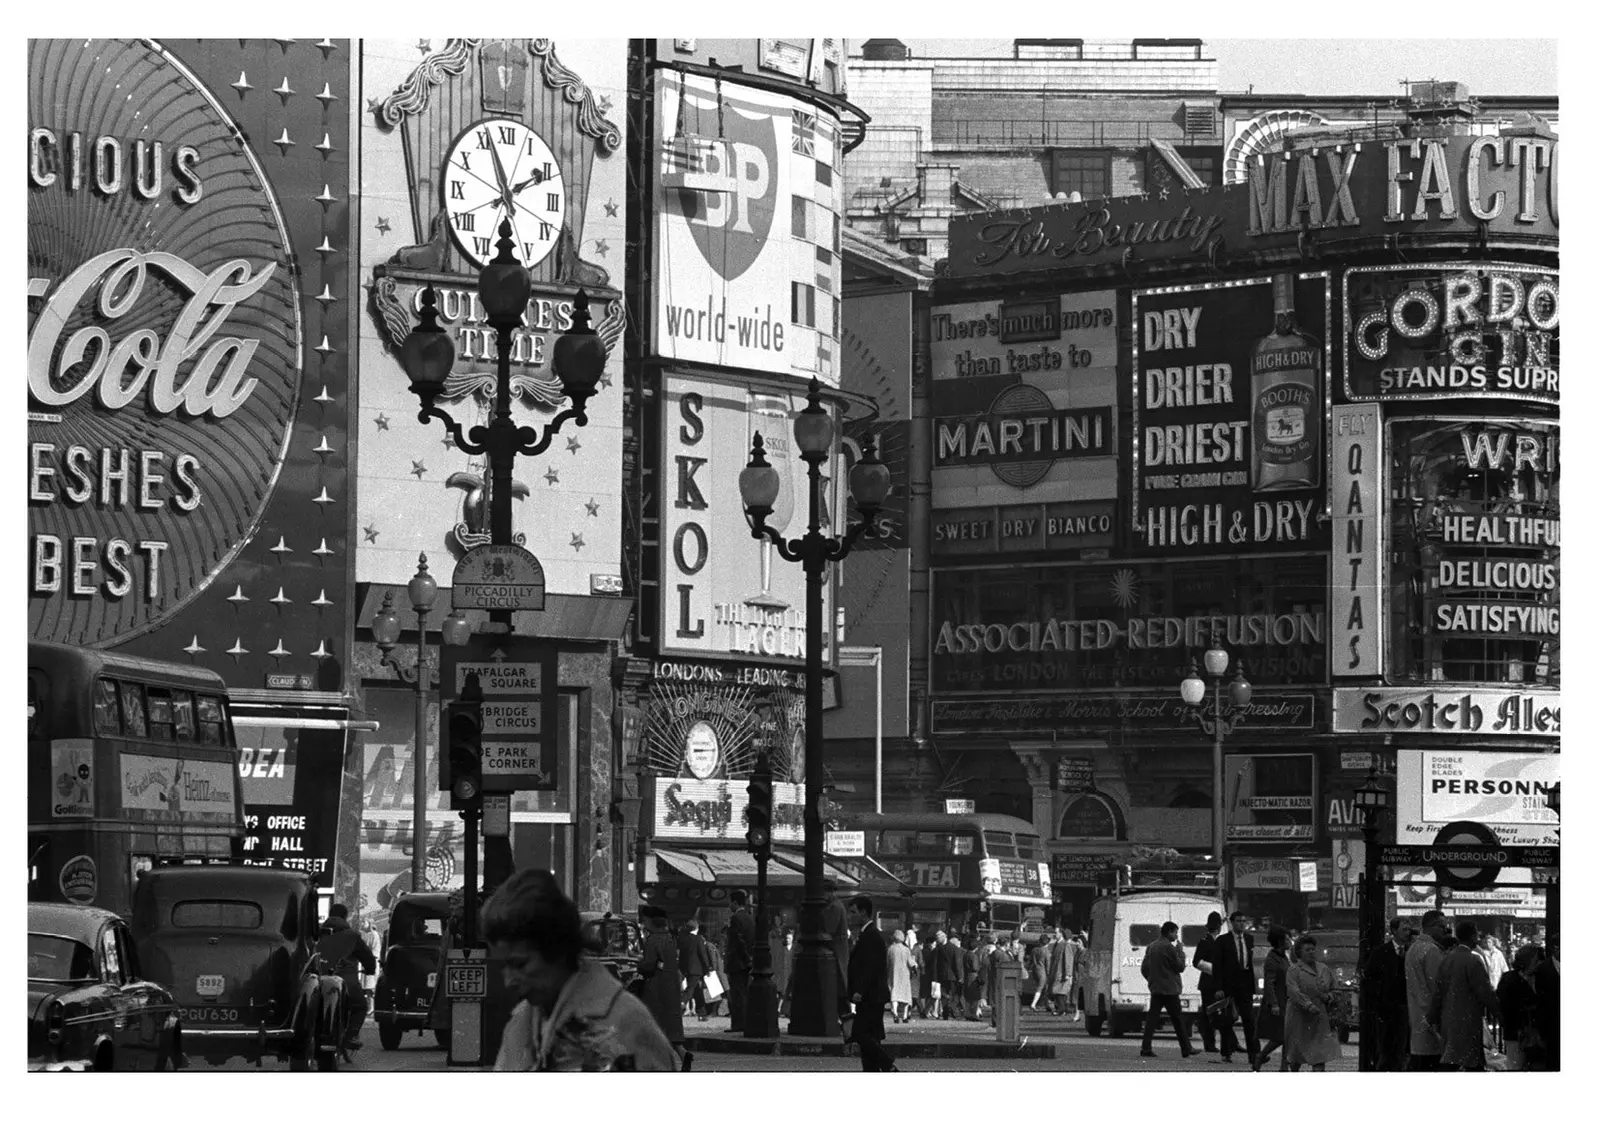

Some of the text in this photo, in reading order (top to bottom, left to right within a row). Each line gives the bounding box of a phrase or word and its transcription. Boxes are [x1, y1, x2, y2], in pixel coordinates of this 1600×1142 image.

[498, 126, 516, 145] XII
[31, 127, 201, 204] CIOUS
[460, 151, 470, 170] X
[543, 162, 552, 181] II
[450, 181, 465, 200] IX
[691, 138, 770, 234] BP
[1246, 134, 1558, 235] MAX FACT
[547, 193, 559, 212] III
[454, 212, 476, 232] VIII
[539, 222, 553, 241] IV
[973, 205, 1224, 266] For Beauty
[524, 242, 534, 260] V
[666, 295, 784, 352] world-wide
[932, 308, 1113, 341] There's much more
[1143, 306, 1202, 351] DRY
[1451, 330, 1553, 368] GIN
[955, 345, 1091, 376] than taste to
[1145, 363, 1234, 409] DRIER
[1380, 366, 1487, 389] STANDS
[1338, 413, 1373, 436] FLY
[938, 415, 1102, 459] MARTINI
[1145, 420, 1248, 467] DRIEST
[30, 442, 201, 511] ESHES
[673, 392, 708, 639] SKOL
[1148, 499, 1313, 547] HIGH & DRY
[935, 515, 1110, 541] SWEET DRY BIANCO
[1347, 443, 1363, 669] QANTAS
[34, 534, 168, 598] BEST
[1439, 560, 1555, 589] DELICIOUS
[465, 586, 532, 597] PICCADILLY
[476, 597, 521, 608] CIRCUS
[1437, 604, 1559, 635] SATISFYING
[461, 667, 526, 677] TRAFALGAR
[654, 662, 723, 682] LONDONS
[737, 667, 788, 687] LEADING
[993, 663, 1069, 681] LONDON
[491, 678, 537, 689] SQUARE
[1117, 701, 1167, 718] School
[1362, 693, 1483, 732] Scotch
[495, 717, 537, 728] CIRCUS
[498, 747, 528, 758] PARK
[239, 747, 286, 778] BEA
[489, 758, 536, 769] CORNER
[1432, 779, 1558, 795] PERSONN
[267, 816, 306, 830] OFFICE
[1405, 825, 1424, 835] Keep
[271, 837, 304, 851] HALL
[1512, 836, 1540, 846] Luxury
[283, 858, 328, 873] STREET
[1381, 855, 1412, 863] SUBWAY
[1422, 850, 1508, 863] UNDERGROUND
[913, 863, 955, 886] TEA
[1028, 869, 1037, 881] 38
[1008, 887, 1034, 896] VICTORIA
[199, 978, 222, 987] 5892
[450, 970, 482, 981] KEEP
[452, 982, 480, 992] LEFT
[180, 1010, 238, 1021] PGU 630
